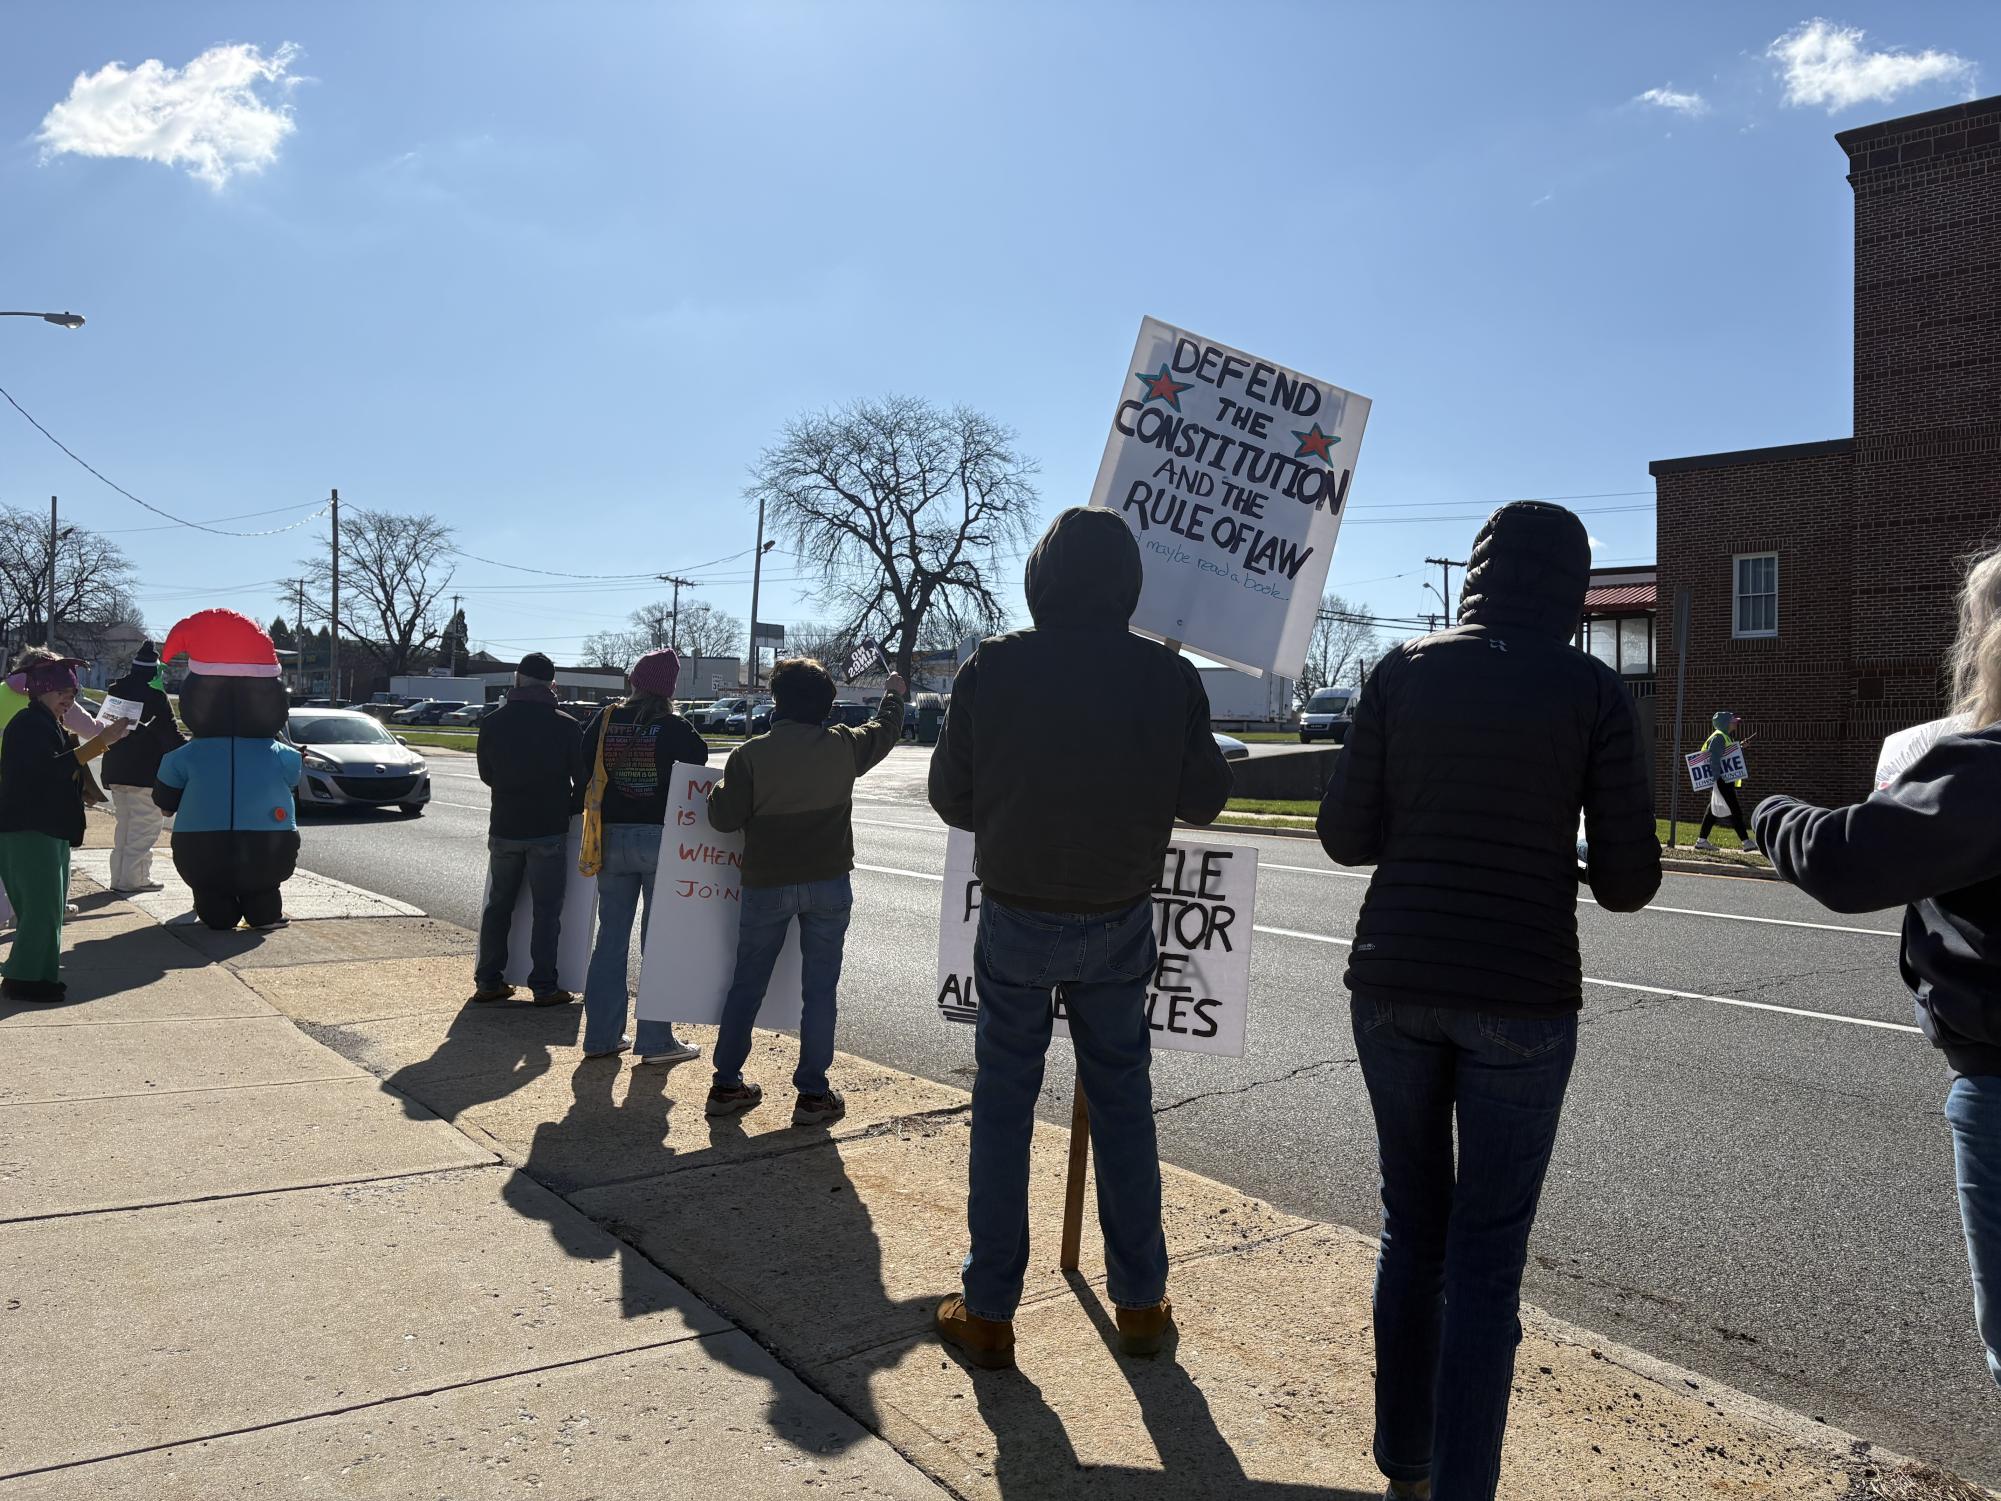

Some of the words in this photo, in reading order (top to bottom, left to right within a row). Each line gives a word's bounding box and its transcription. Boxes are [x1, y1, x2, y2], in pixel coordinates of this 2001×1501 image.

[1171, 337, 1322, 417] DEFEND
[1216, 396, 1274, 440] THE
[1115, 399, 1350, 516] CONSTITUTION
[1153, 458, 1215, 498] AND
[1221, 479, 1270, 520] THE
[1122, 480, 1214, 543] RULE
[1146, 539, 1191, 565] maybe
[1198, 562, 1230, 578] read
[1691, 755, 1743, 781] DRKE
[679, 842, 743, 869] WHEN
[937, 973, 978, 1008] AL
